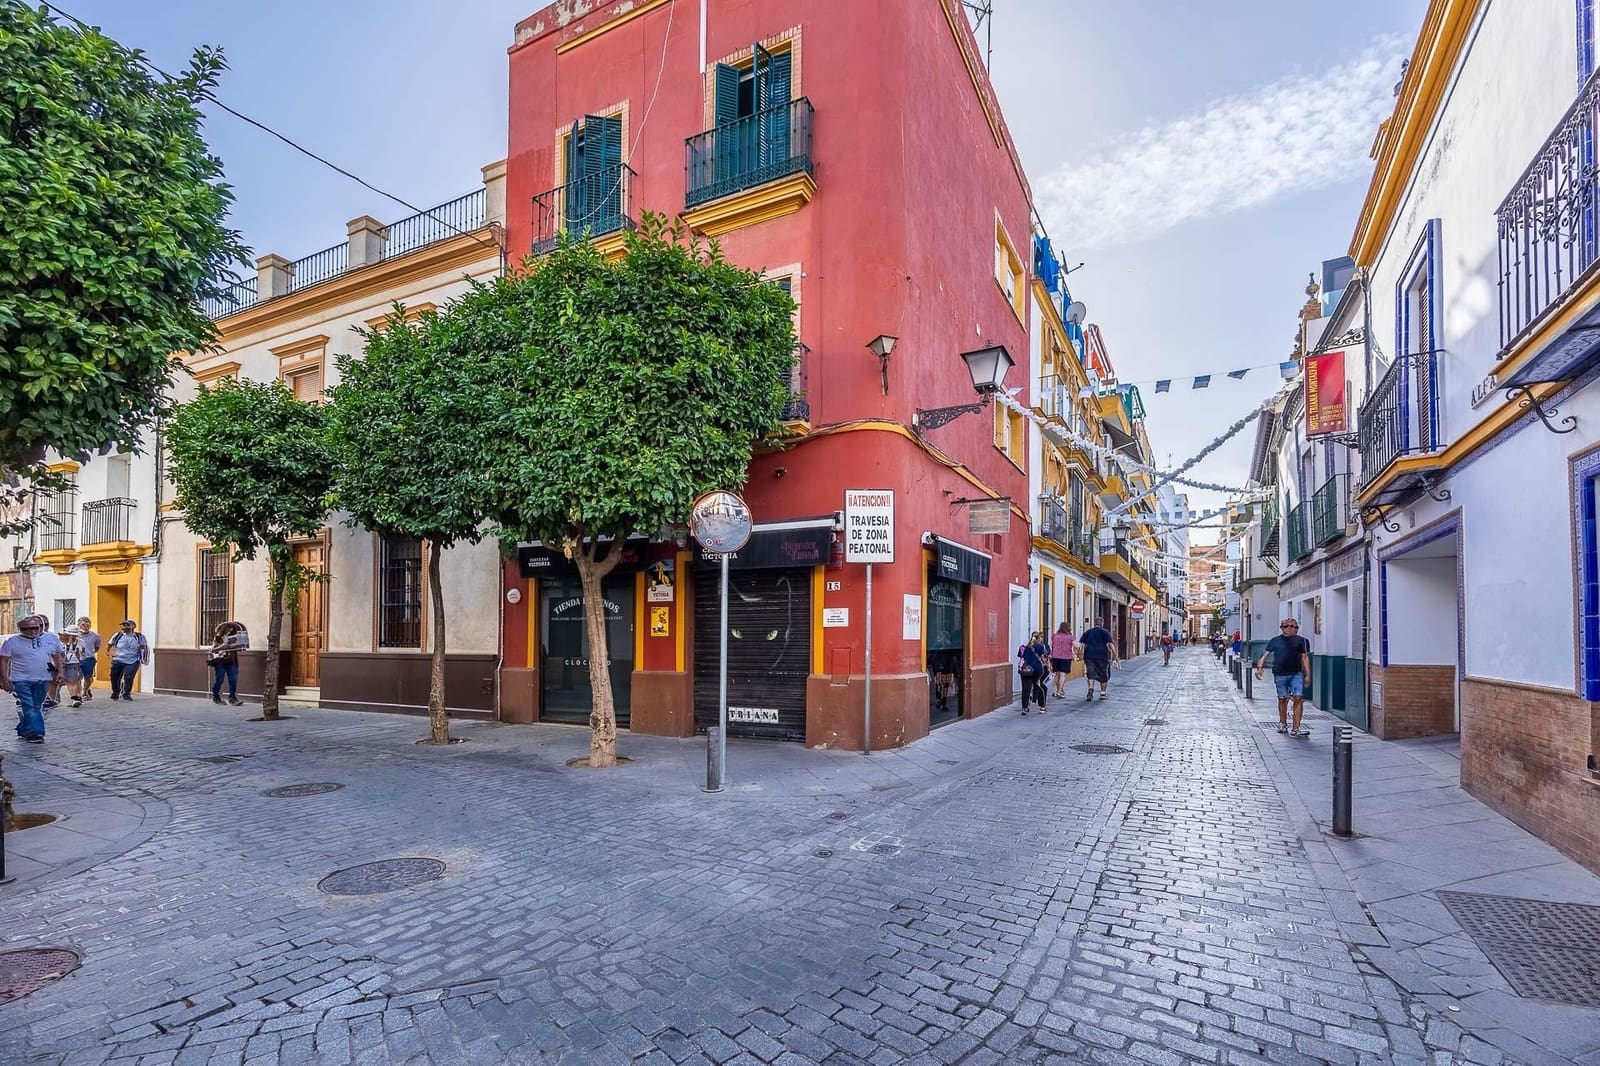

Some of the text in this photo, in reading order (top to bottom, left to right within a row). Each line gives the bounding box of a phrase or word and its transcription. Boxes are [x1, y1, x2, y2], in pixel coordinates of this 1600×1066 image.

[1309, 392, 1319, 414] TRIANA
[1309, 414, 1319, 431] HOTEL
[850, 515, 889, 526] TRAVESIA
[852, 529, 888, 540] DE ZONA
[849, 543, 891, 554] PEATONAL
[828, 582, 839, 590] 15
[553, 597, 580, 615] TIENDA
[729, 709, 778, 721] TRIANA
